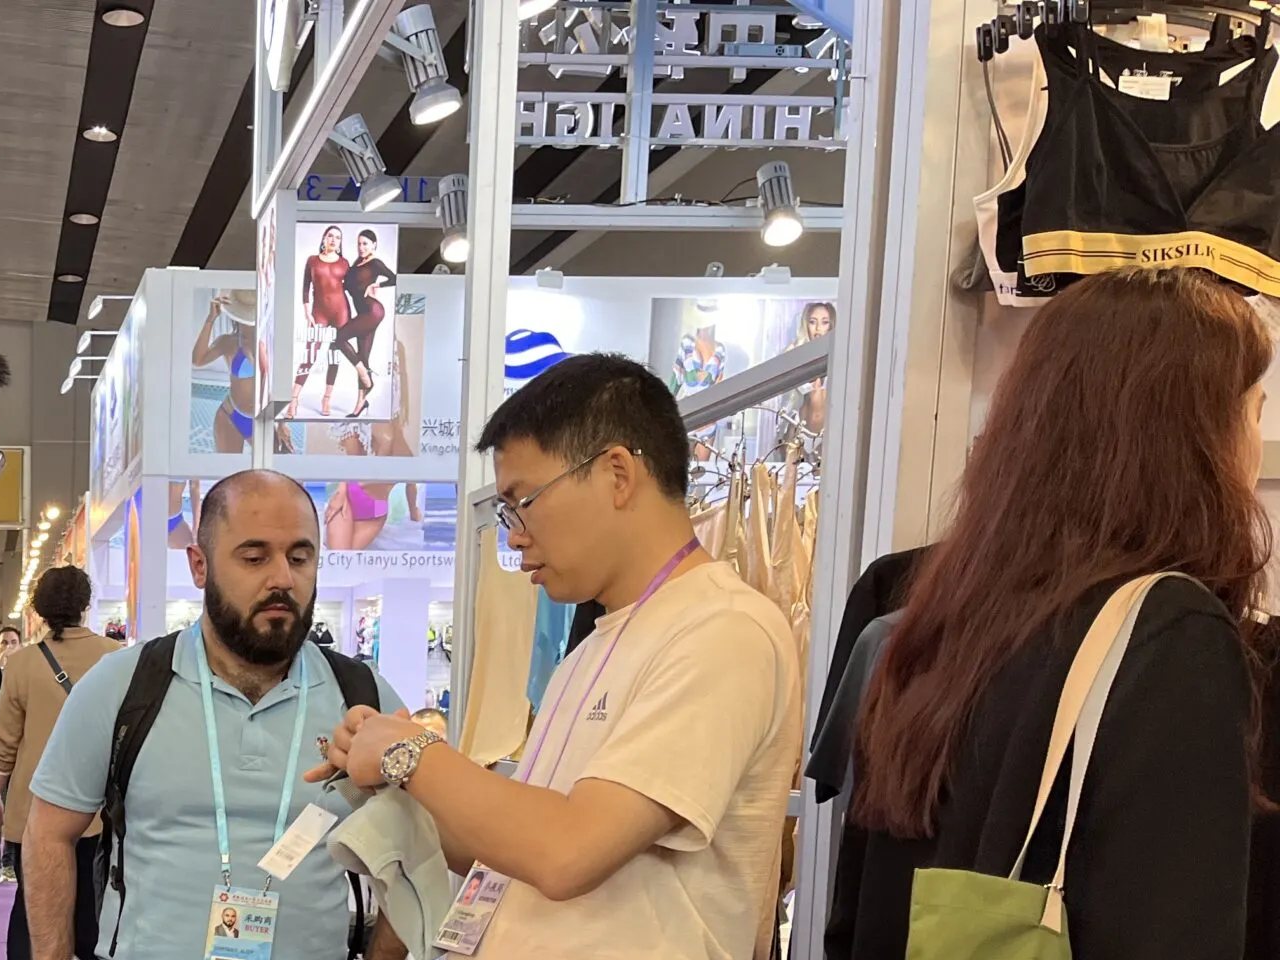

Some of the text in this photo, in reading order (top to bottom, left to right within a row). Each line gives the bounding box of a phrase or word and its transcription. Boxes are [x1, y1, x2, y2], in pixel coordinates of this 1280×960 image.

[1141, 243, 1216, 263] SIKSILK
[327, 552, 353, 569] City
[356, 552, 398, 569] Tianyu
[401, 552, 455, 569] Sportsw
